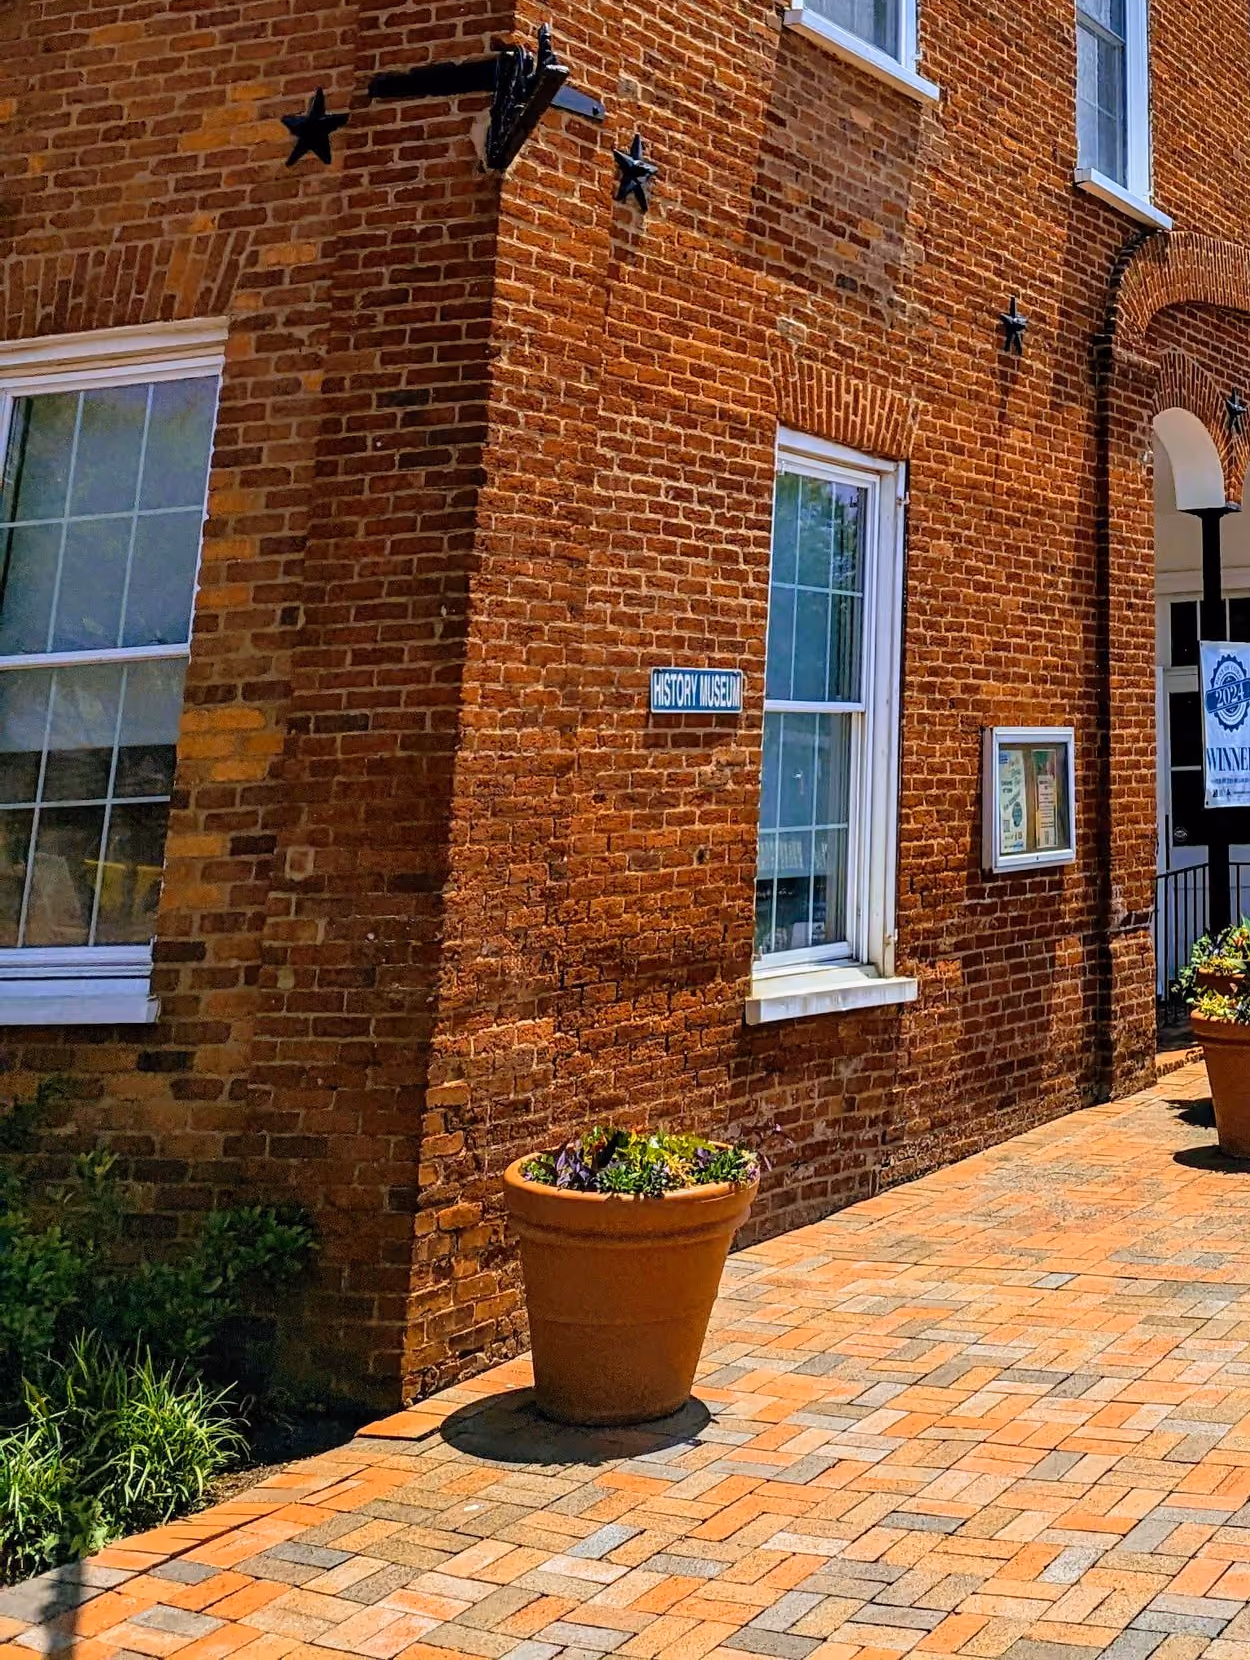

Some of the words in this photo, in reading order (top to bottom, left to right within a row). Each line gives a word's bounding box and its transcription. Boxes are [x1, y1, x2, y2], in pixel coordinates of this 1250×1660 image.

[653, 672, 698, 707] HISTORY
[699, 673, 740, 708] MUSEUM
[1216, 682, 1244, 708] 2024
